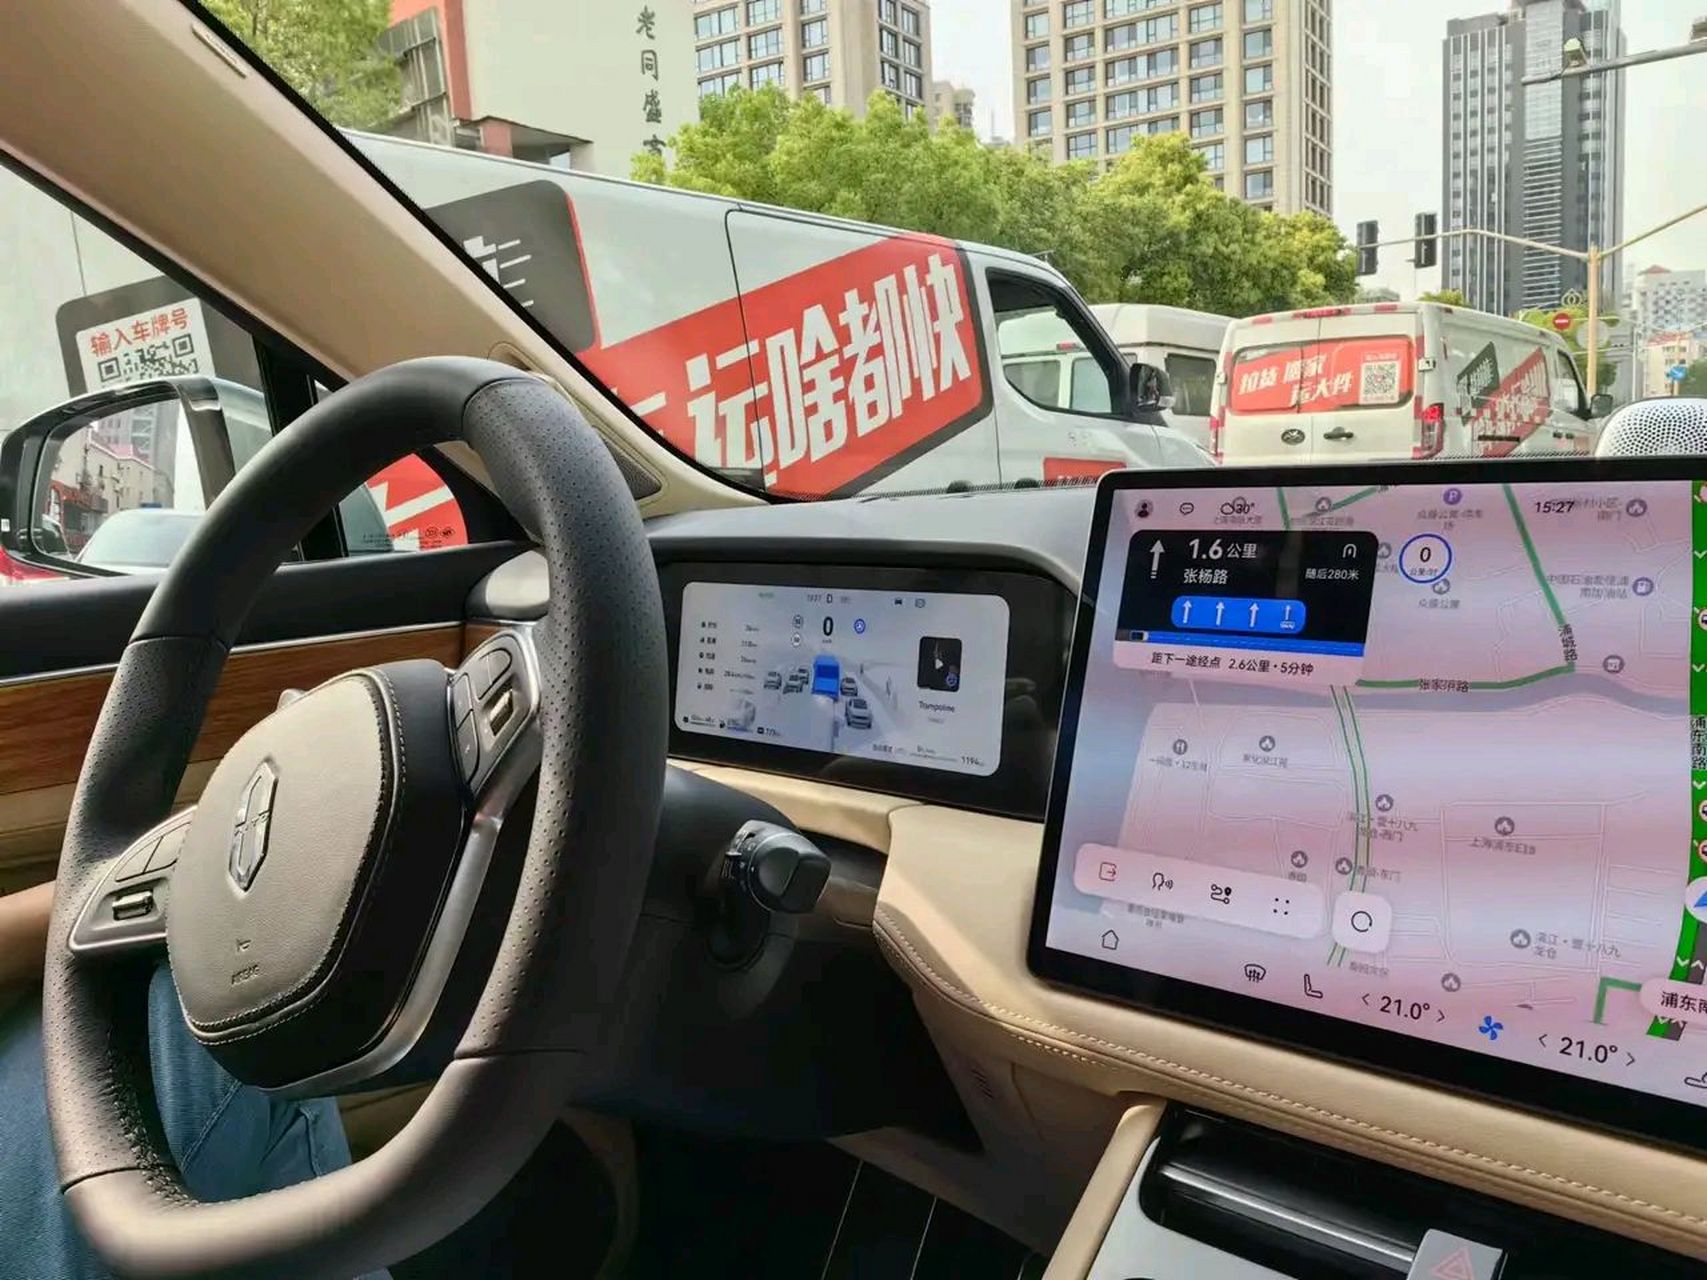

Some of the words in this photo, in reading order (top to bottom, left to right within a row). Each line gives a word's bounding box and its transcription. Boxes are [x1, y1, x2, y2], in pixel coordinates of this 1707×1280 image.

[90, 307, 188, 359] 输入车牌号
[618, 253, 971, 488] 运啥都快
[1535, 500, 1575, 514] 15:27
[1188, 538, 1223, 560] 1.6
[1227, 543, 1258, 559] 公里
[1420, 546, 1432, 563] 0
[1183, 568, 1229, 585] 张杨路
[1304, 567, 1360, 581] 随后280米
[823, 616, 834, 636] 0
[1151, 650, 1221, 669] 距下一途经点
[1379, 995, 1431, 1020] 21.0°
[1559, 1036, 1619, 1064] 21.0°
